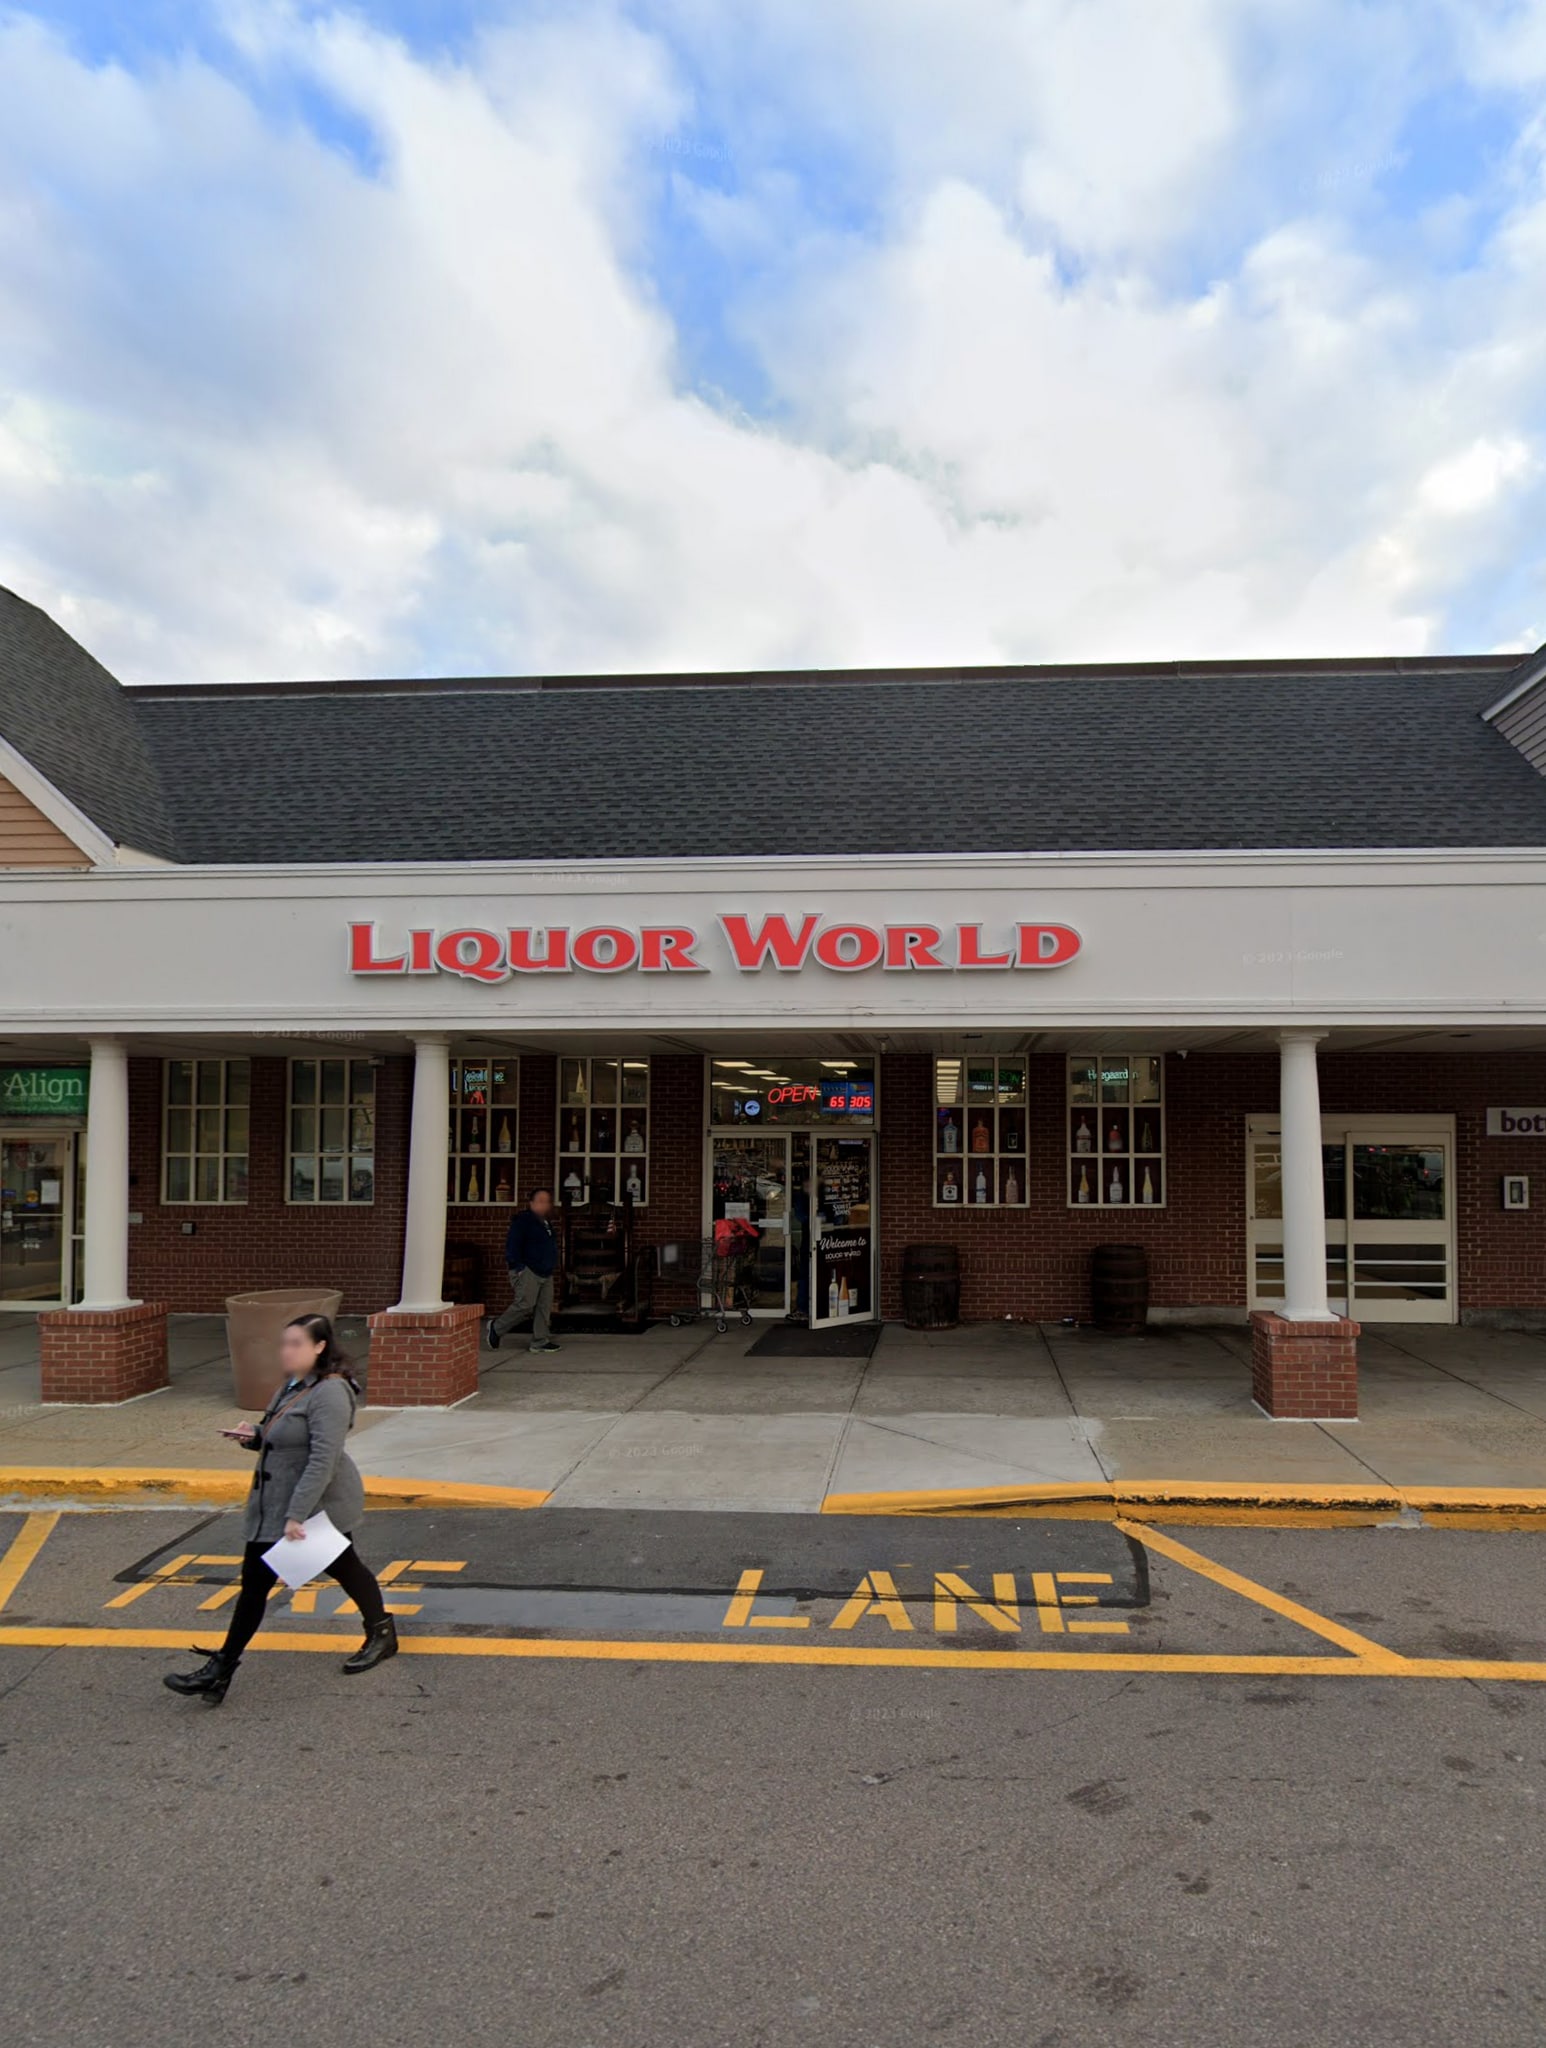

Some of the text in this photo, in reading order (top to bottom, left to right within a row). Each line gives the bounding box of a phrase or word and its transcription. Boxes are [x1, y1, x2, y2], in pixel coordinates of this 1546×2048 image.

[347, 913, 1084, 984] LIQUOR WORLD
[3, 1072, 84, 1103] Align
[767, 1085, 818, 1104] OPEN
[830, 1096, 872, 1108] 65 305
[1501, 1110, 1546, 1132] bot
[819, 1236, 867, 1251] Welcome to
[722, 1569, 1130, 1633] LANE
